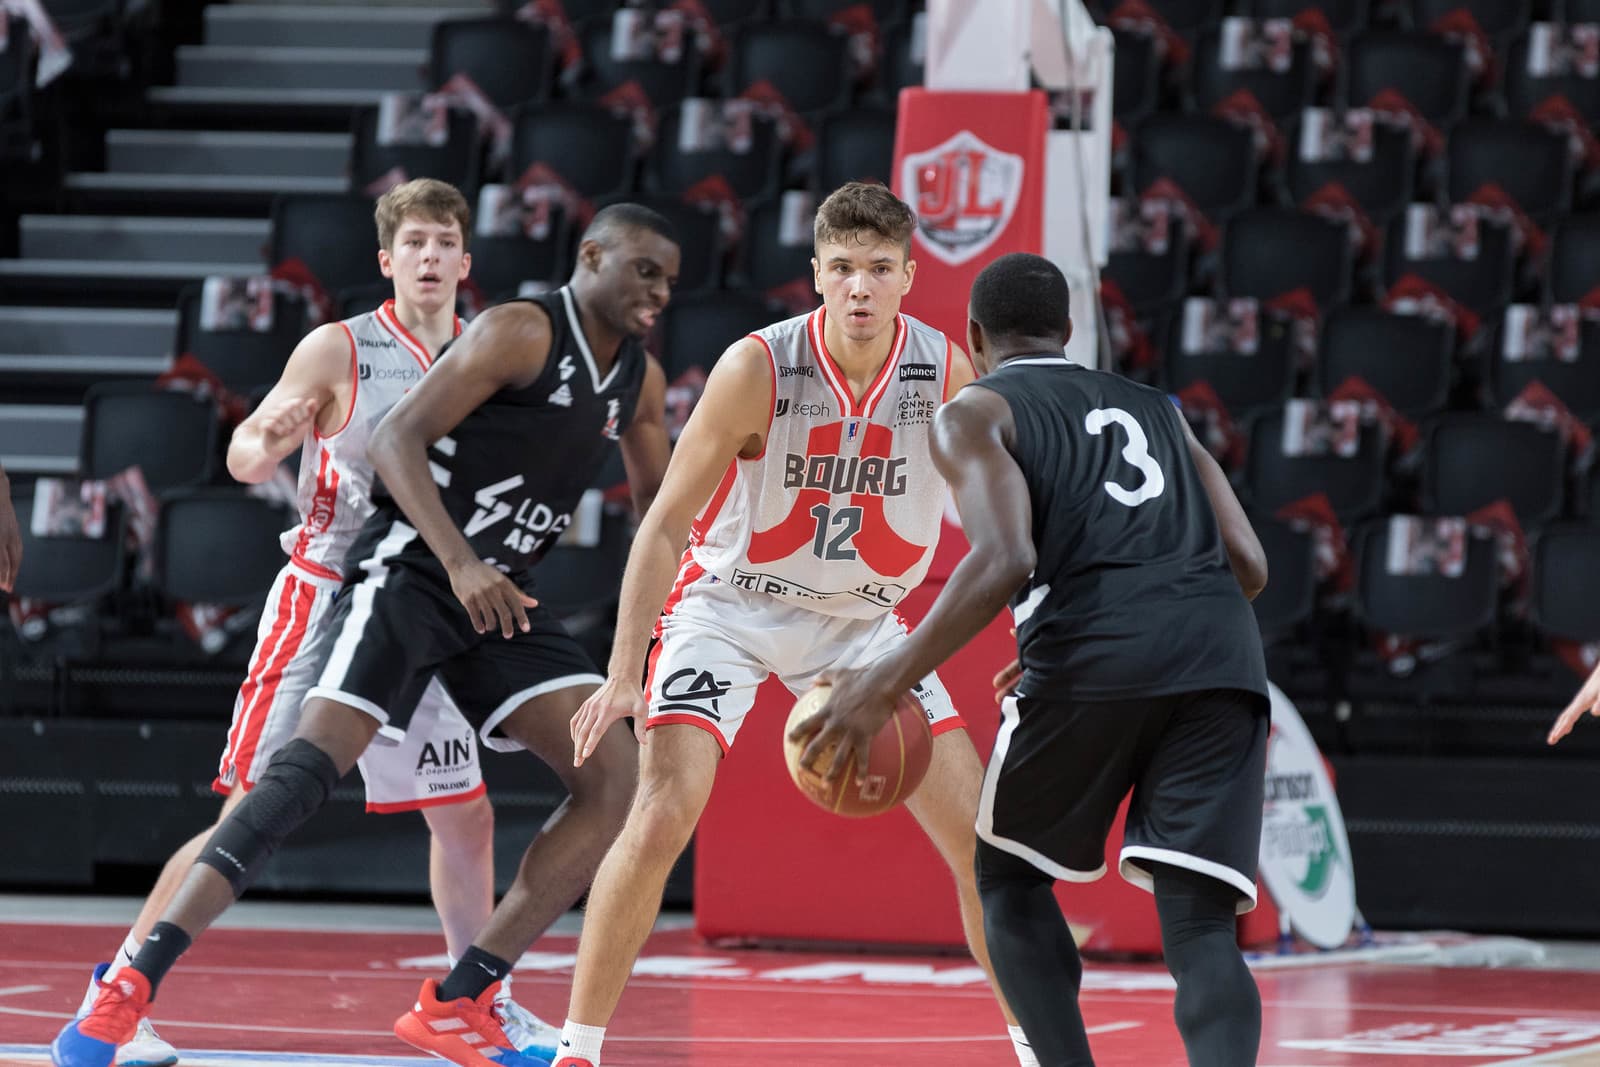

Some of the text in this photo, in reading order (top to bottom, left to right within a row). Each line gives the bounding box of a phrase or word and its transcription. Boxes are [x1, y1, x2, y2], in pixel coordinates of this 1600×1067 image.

[783, 453, 908, 496] BOURG
[1085, 407, 1165, 507] 3
[811, 504, 863, 561] 12
[416, 738, 470, 770] AIN
